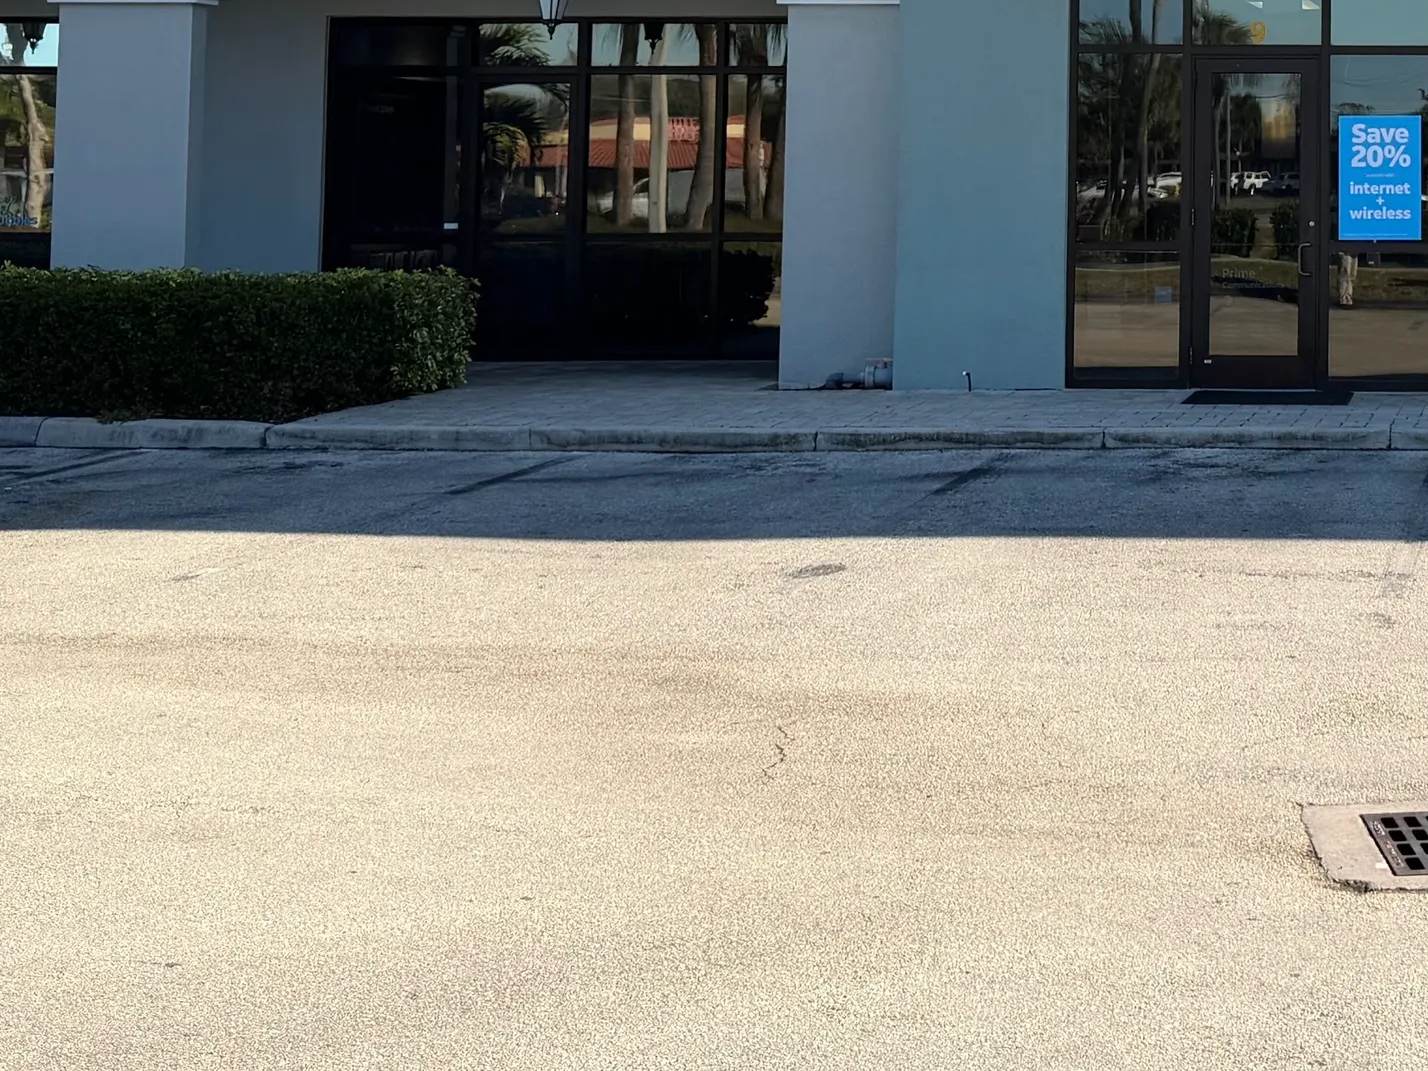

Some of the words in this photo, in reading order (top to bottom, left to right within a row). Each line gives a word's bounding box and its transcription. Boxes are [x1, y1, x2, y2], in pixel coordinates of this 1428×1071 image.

[1250, 20, 1266, 44] 9
[1351, 123, 1410, 144] Save
[1351, 145, 1412, 168] 20%
[1349, 181, 1412, 195] internet
[1375, 196, 1385, 205] +
[1349, 206, 1412, 220] wireless
[1221, 268, 1256, 279] Prime
